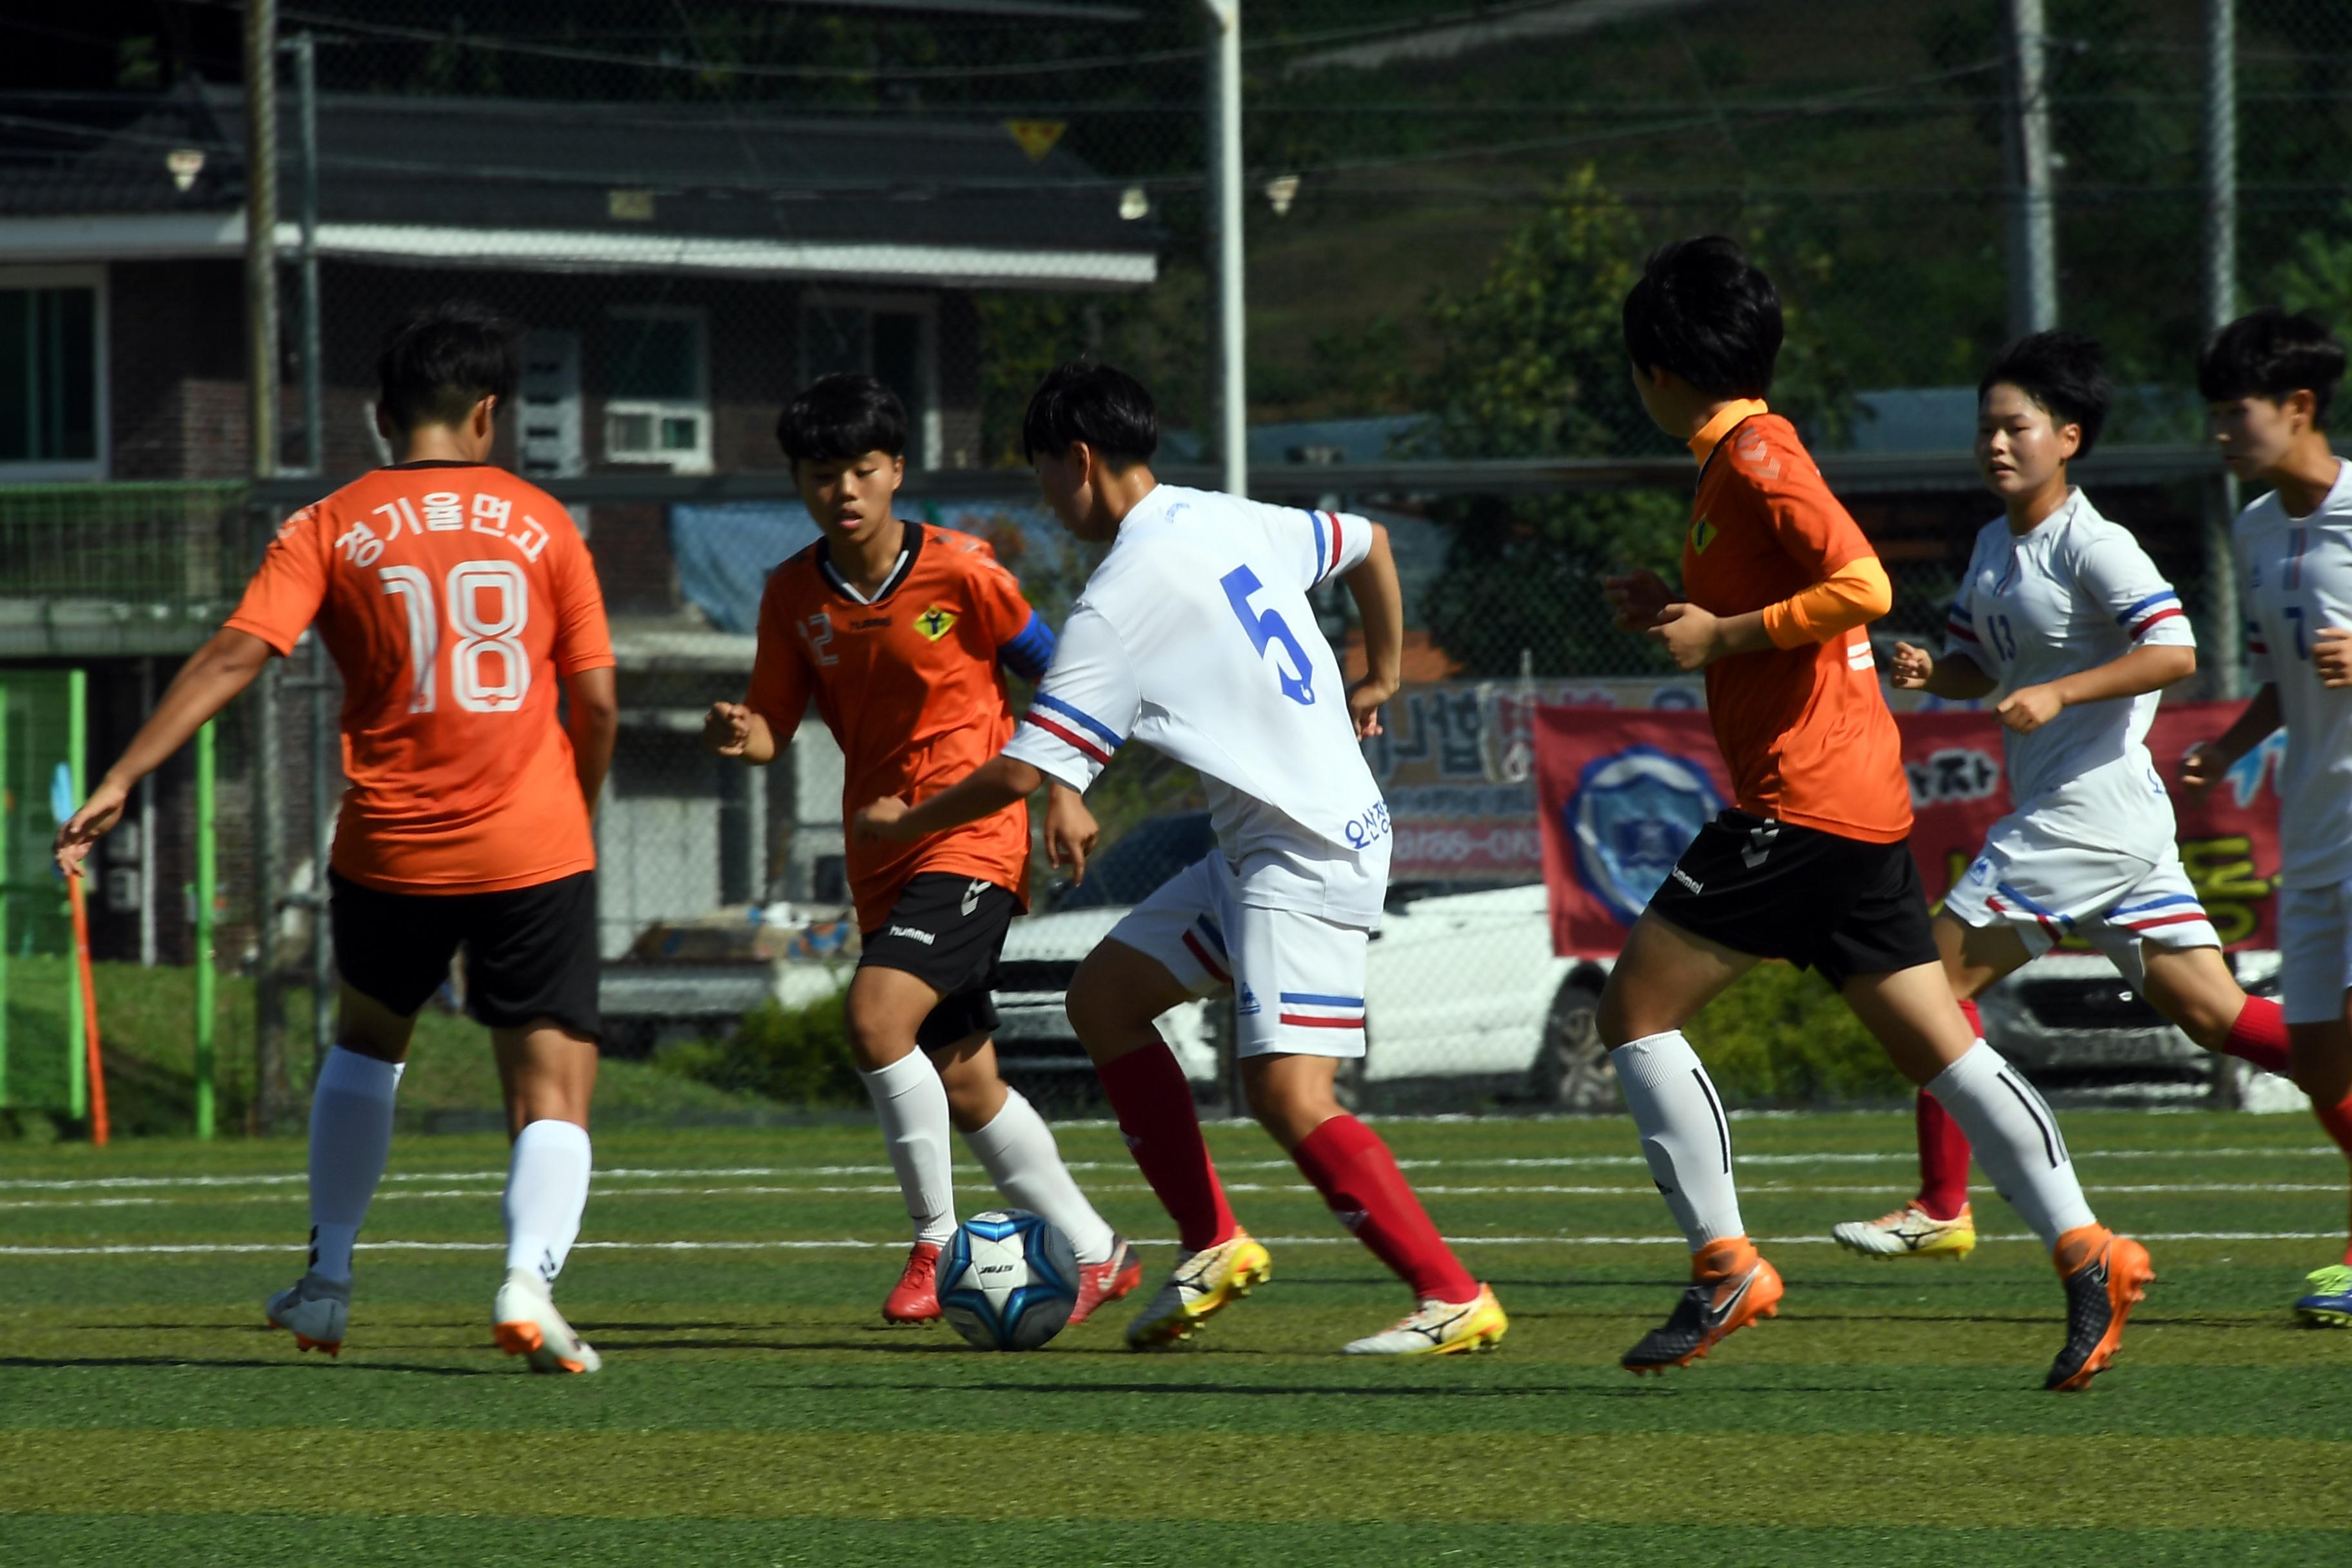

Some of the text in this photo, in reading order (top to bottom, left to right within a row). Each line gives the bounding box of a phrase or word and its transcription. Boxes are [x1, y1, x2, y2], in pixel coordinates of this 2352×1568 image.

[335, 491, 550, 567] 경기율면고
[379, 560, 531, 713] 18
[1219, 563, 1316, 706] 5
[1987, 614, 2017, 662] 13
[1345, 799, 1391, 850] 오산정
[889, 925, 936, 946] hummel
